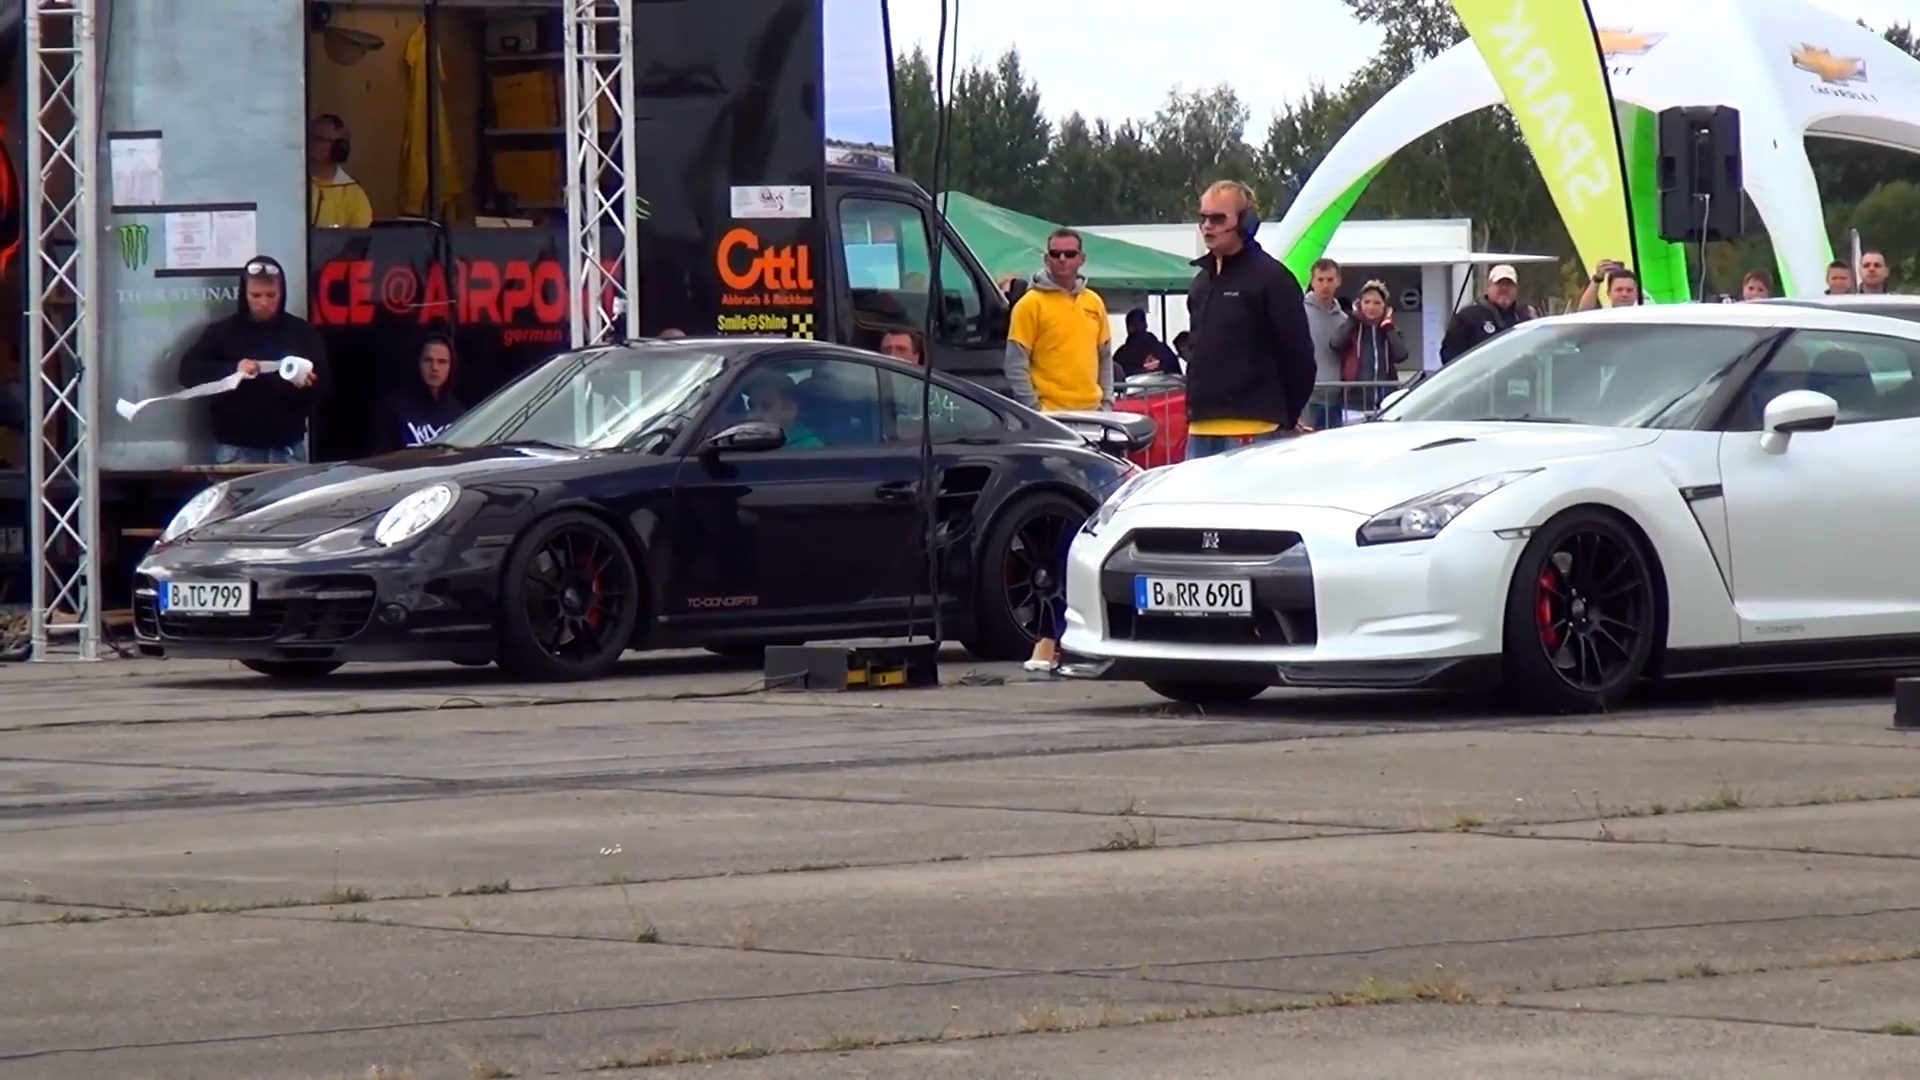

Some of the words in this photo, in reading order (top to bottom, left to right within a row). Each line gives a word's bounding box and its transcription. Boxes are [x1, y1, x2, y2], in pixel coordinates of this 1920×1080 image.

[503, 328, 563, 346] german
[172, 584, 181, 607] B
[1153, 582, 1165, 606] B
[1176, 583, 1201, 607] RR
[1205, 583, 1244, 607] 690
